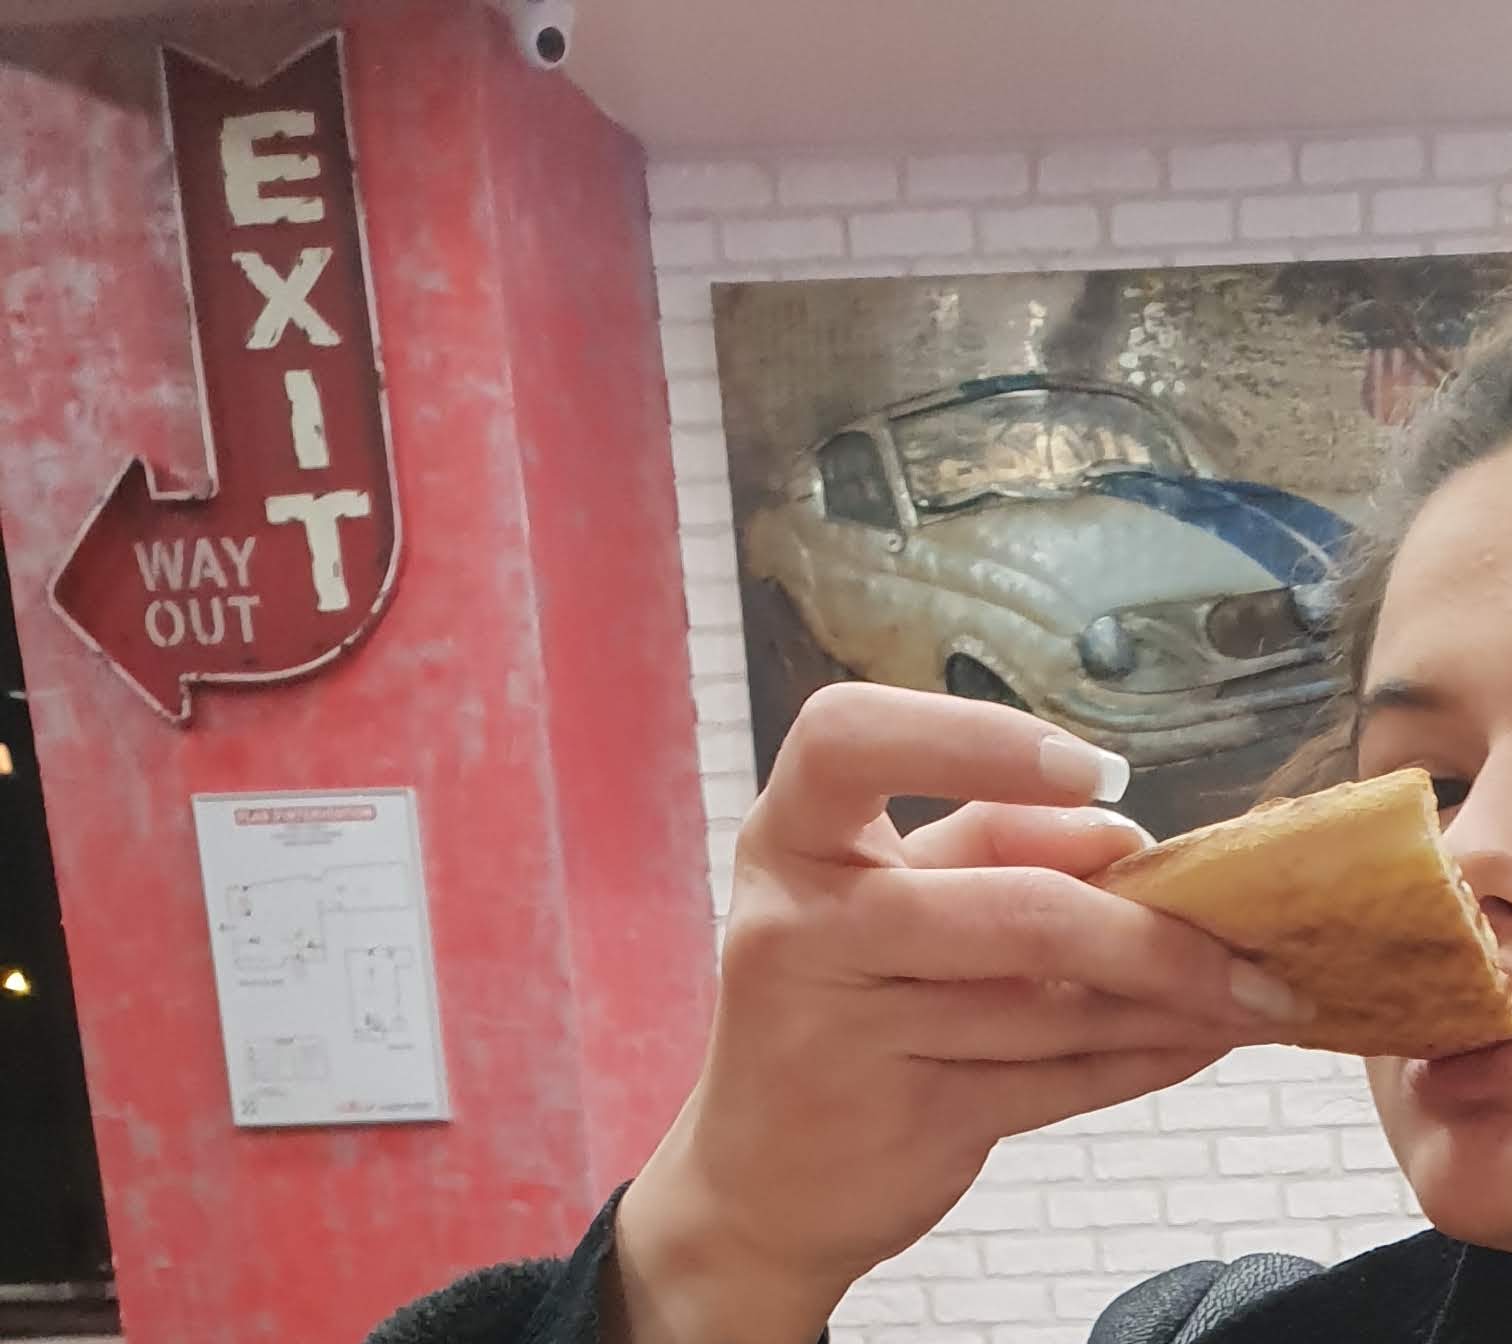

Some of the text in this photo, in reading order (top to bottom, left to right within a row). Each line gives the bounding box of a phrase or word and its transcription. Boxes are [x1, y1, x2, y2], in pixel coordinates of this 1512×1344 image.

[220, 109, 371, 612] EXIT
[134, 536, 257, 591] WAY
[144, 596, 260, 647] OUT
